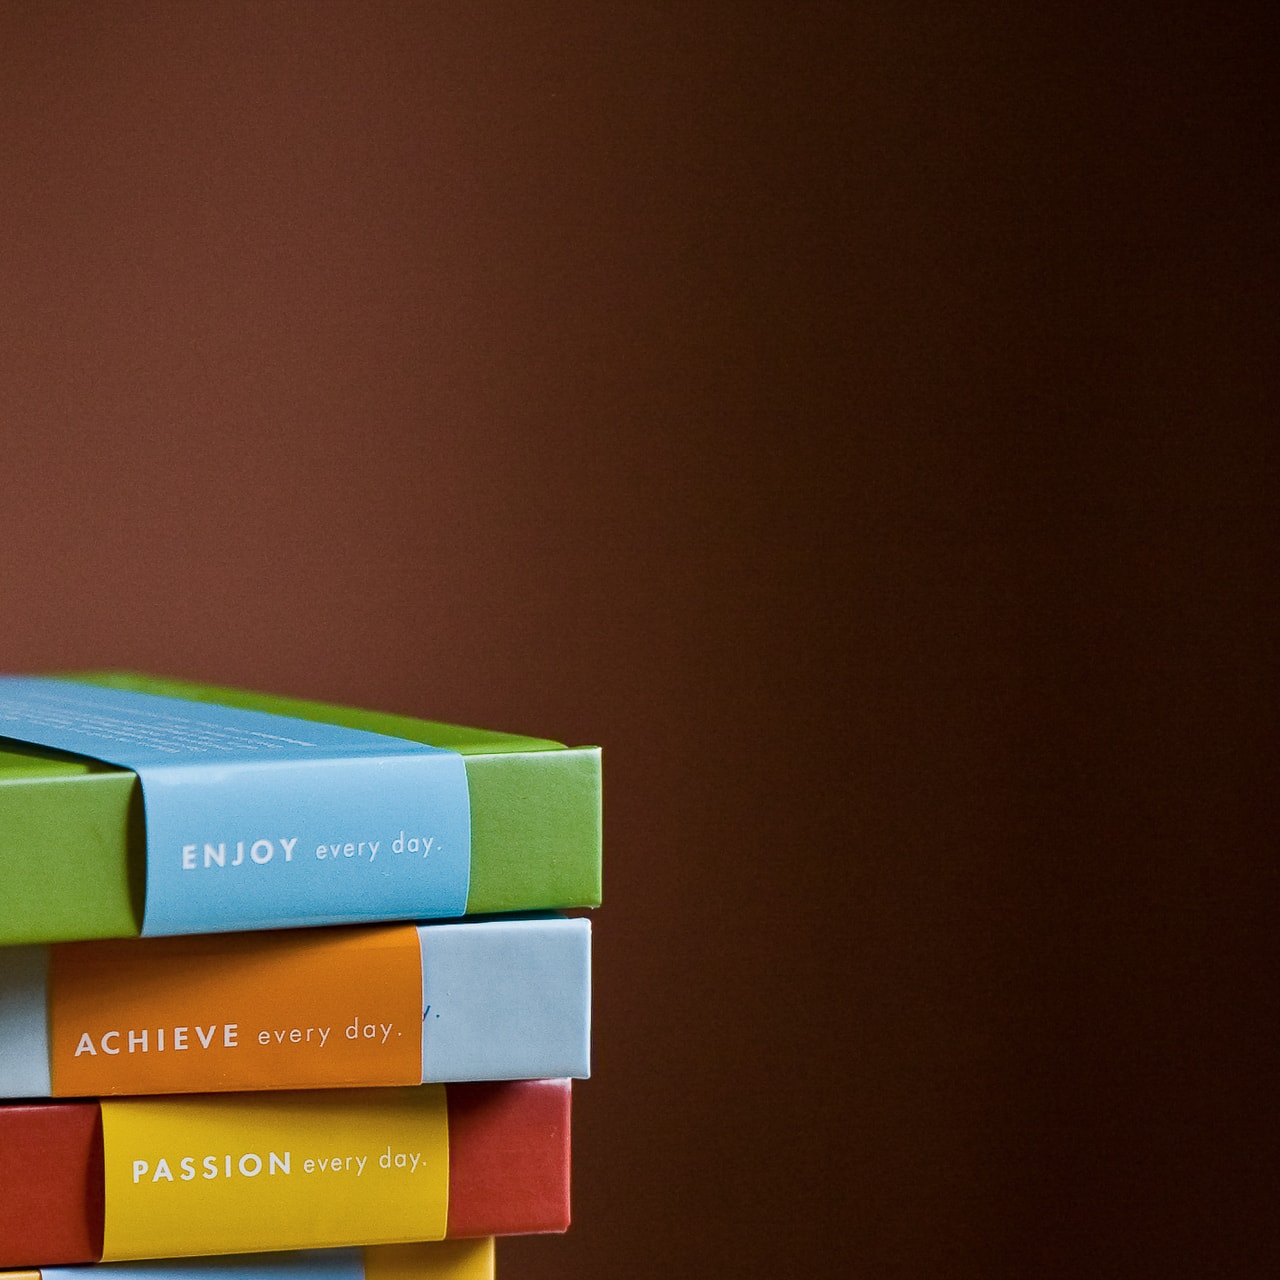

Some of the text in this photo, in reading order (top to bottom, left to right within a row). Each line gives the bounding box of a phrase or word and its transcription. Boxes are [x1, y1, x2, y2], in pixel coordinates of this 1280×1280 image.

[181, 830, 443, 871] ENJOY every day.
[73, 1016, 404, 1057] ACHIEVE every day.
[132, 1145, 428, 1184] PASSION every day.
